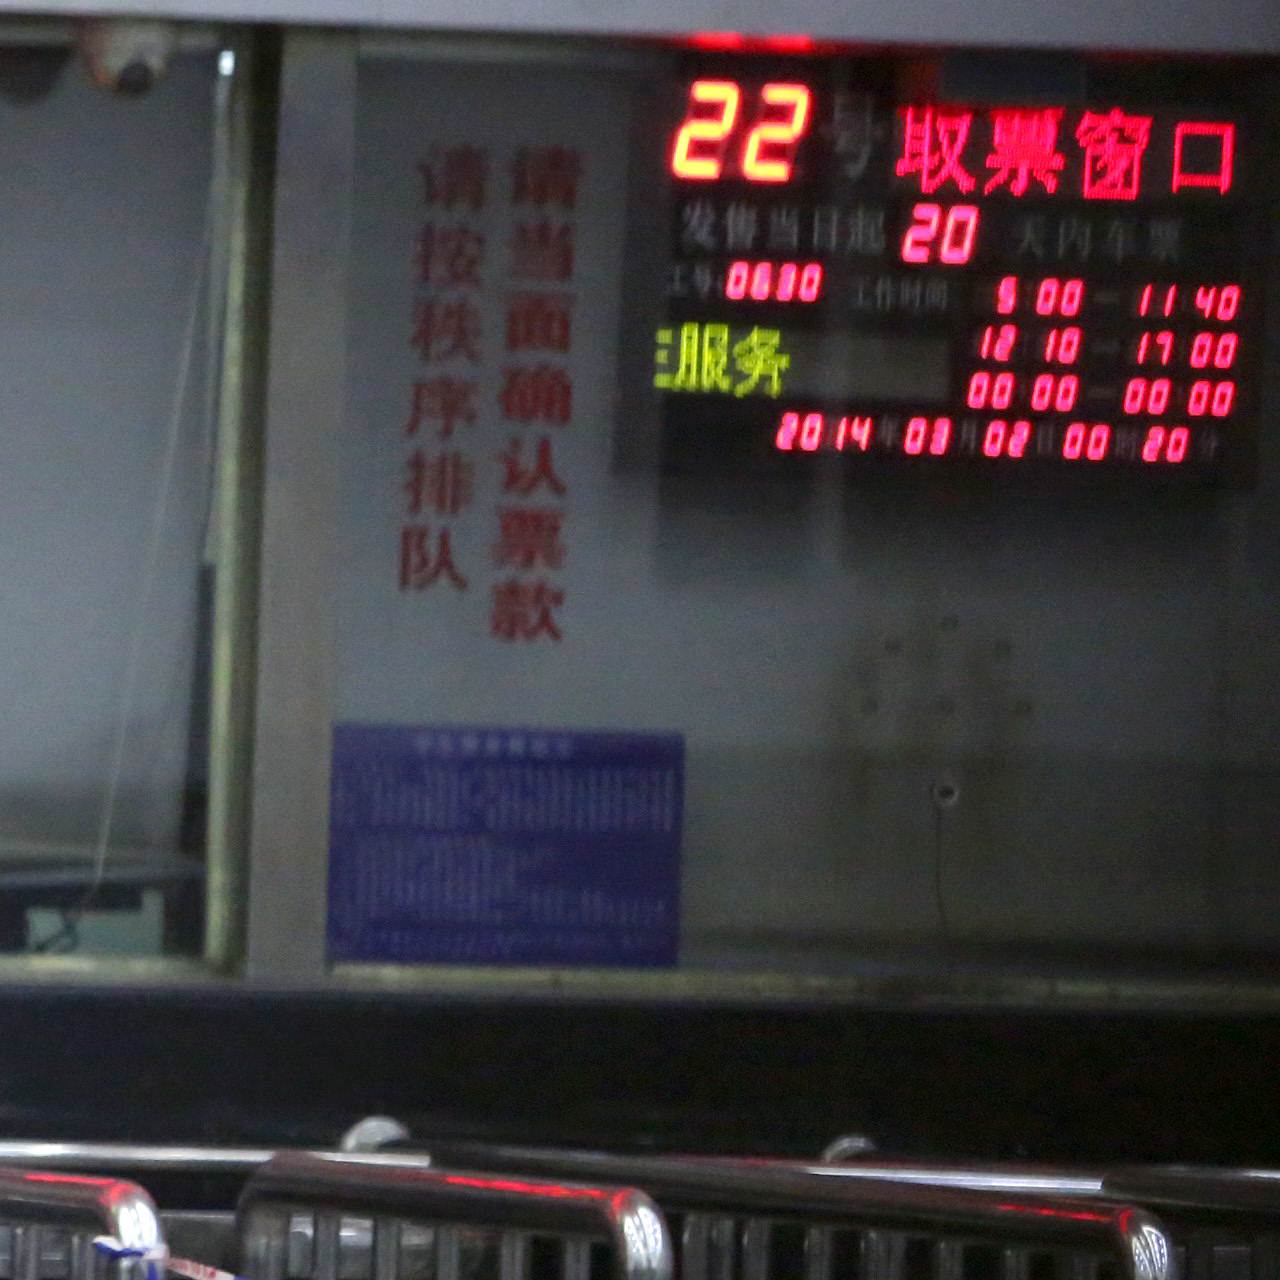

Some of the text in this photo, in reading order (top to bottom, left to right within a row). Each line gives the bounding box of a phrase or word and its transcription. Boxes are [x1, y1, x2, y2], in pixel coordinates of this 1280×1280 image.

[669, 79, 813, 184] 22
[896, 106, 1234, 200] 取票窗口
[901, 203, 980, 264] 20
[776, 412, 872, 451] 2014
